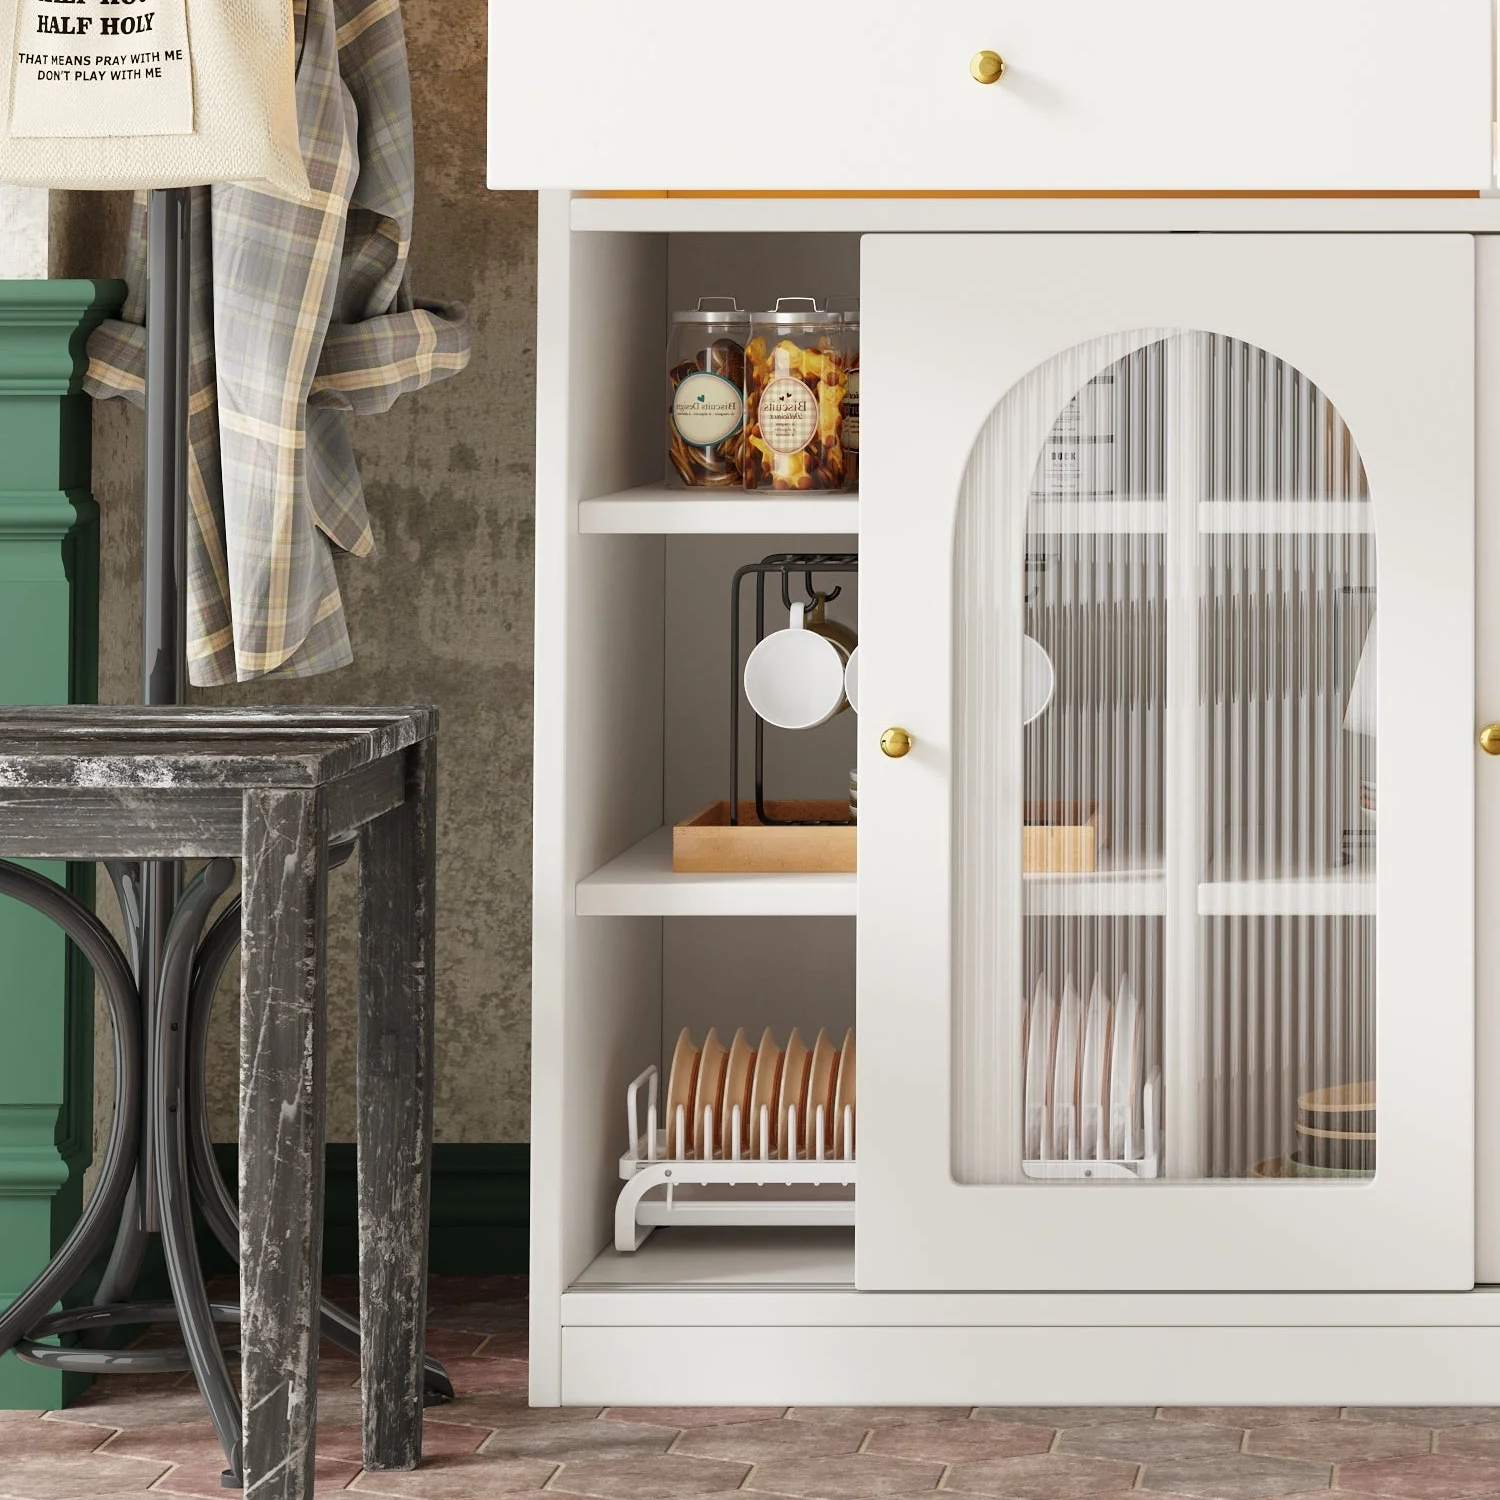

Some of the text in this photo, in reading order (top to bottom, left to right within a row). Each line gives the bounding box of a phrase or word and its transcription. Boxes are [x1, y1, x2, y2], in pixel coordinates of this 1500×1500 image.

[36, 12, 155, 35] HALF HOLY
[18, 49, 183, 66] THAT MEANS PRAY WITH ME
[37, 67, 162, 81] DON'T PLAY WITH ME
